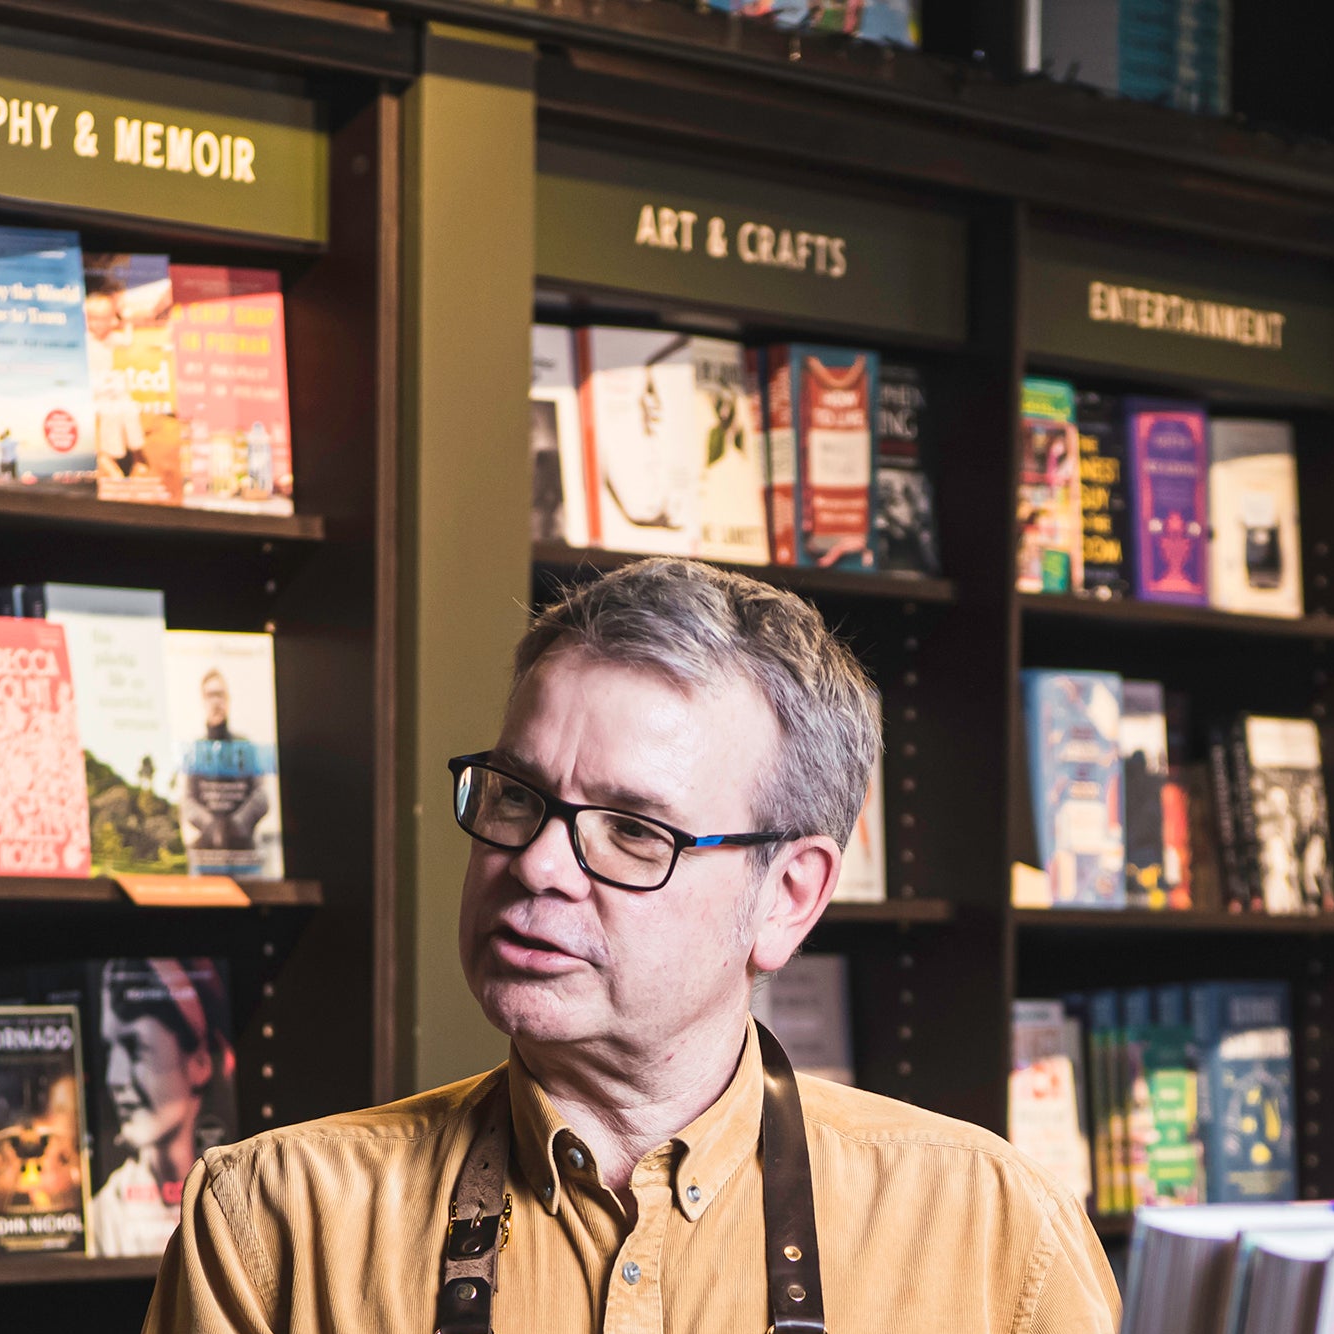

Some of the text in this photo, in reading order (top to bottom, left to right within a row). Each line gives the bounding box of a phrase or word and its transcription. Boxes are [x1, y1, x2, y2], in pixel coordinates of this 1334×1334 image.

[73, 110, 99, 158] &
[113, 116, 257, 183] MEMOIR
[634, 205, 847, 279] ART & CRAFTS
[1087, 281, 1286, 349] ENTERTAINMENT
